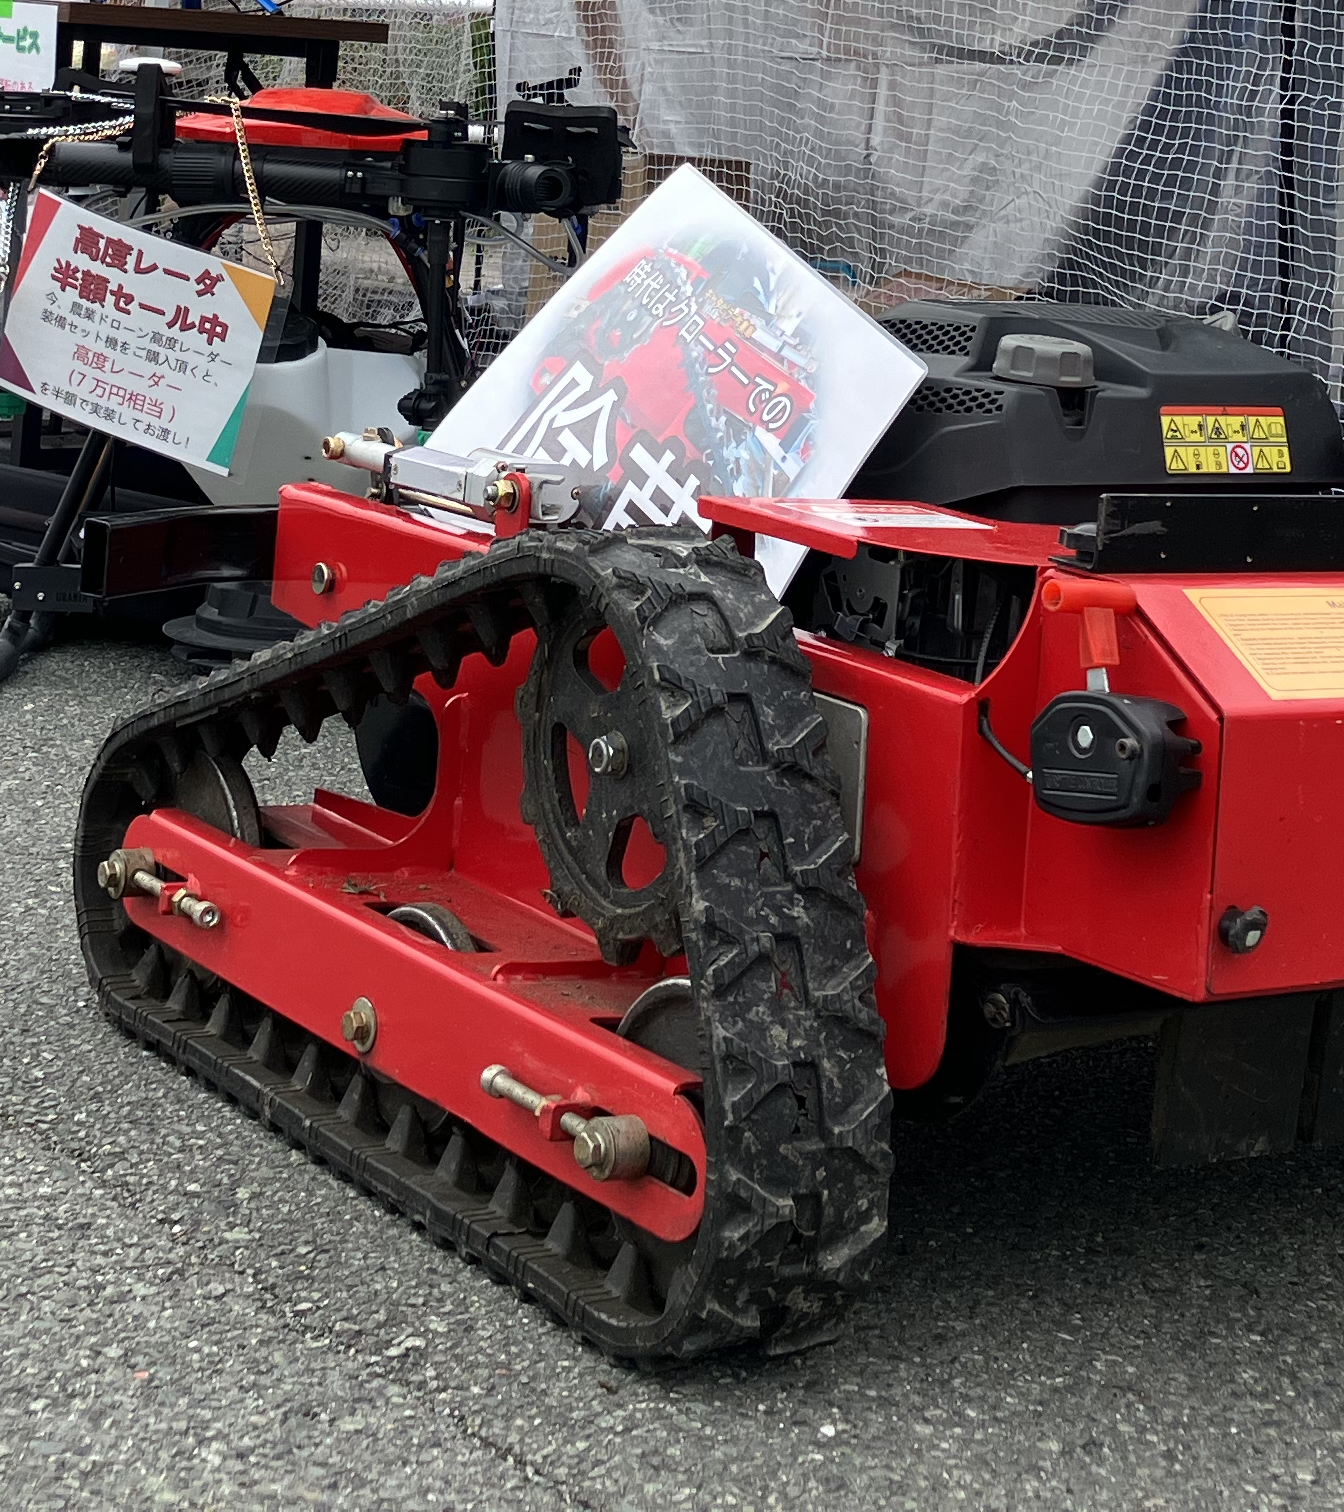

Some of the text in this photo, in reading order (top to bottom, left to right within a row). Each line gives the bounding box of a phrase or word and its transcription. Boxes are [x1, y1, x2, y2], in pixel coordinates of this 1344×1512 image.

[72, 223, 225, 297] 高度レーダ
[50, 257, 230, 345] 半額セール中
[71, 343, 183, 392] 高度レーダー
[623, 258, 792, 431] 時代はクローラーでの
